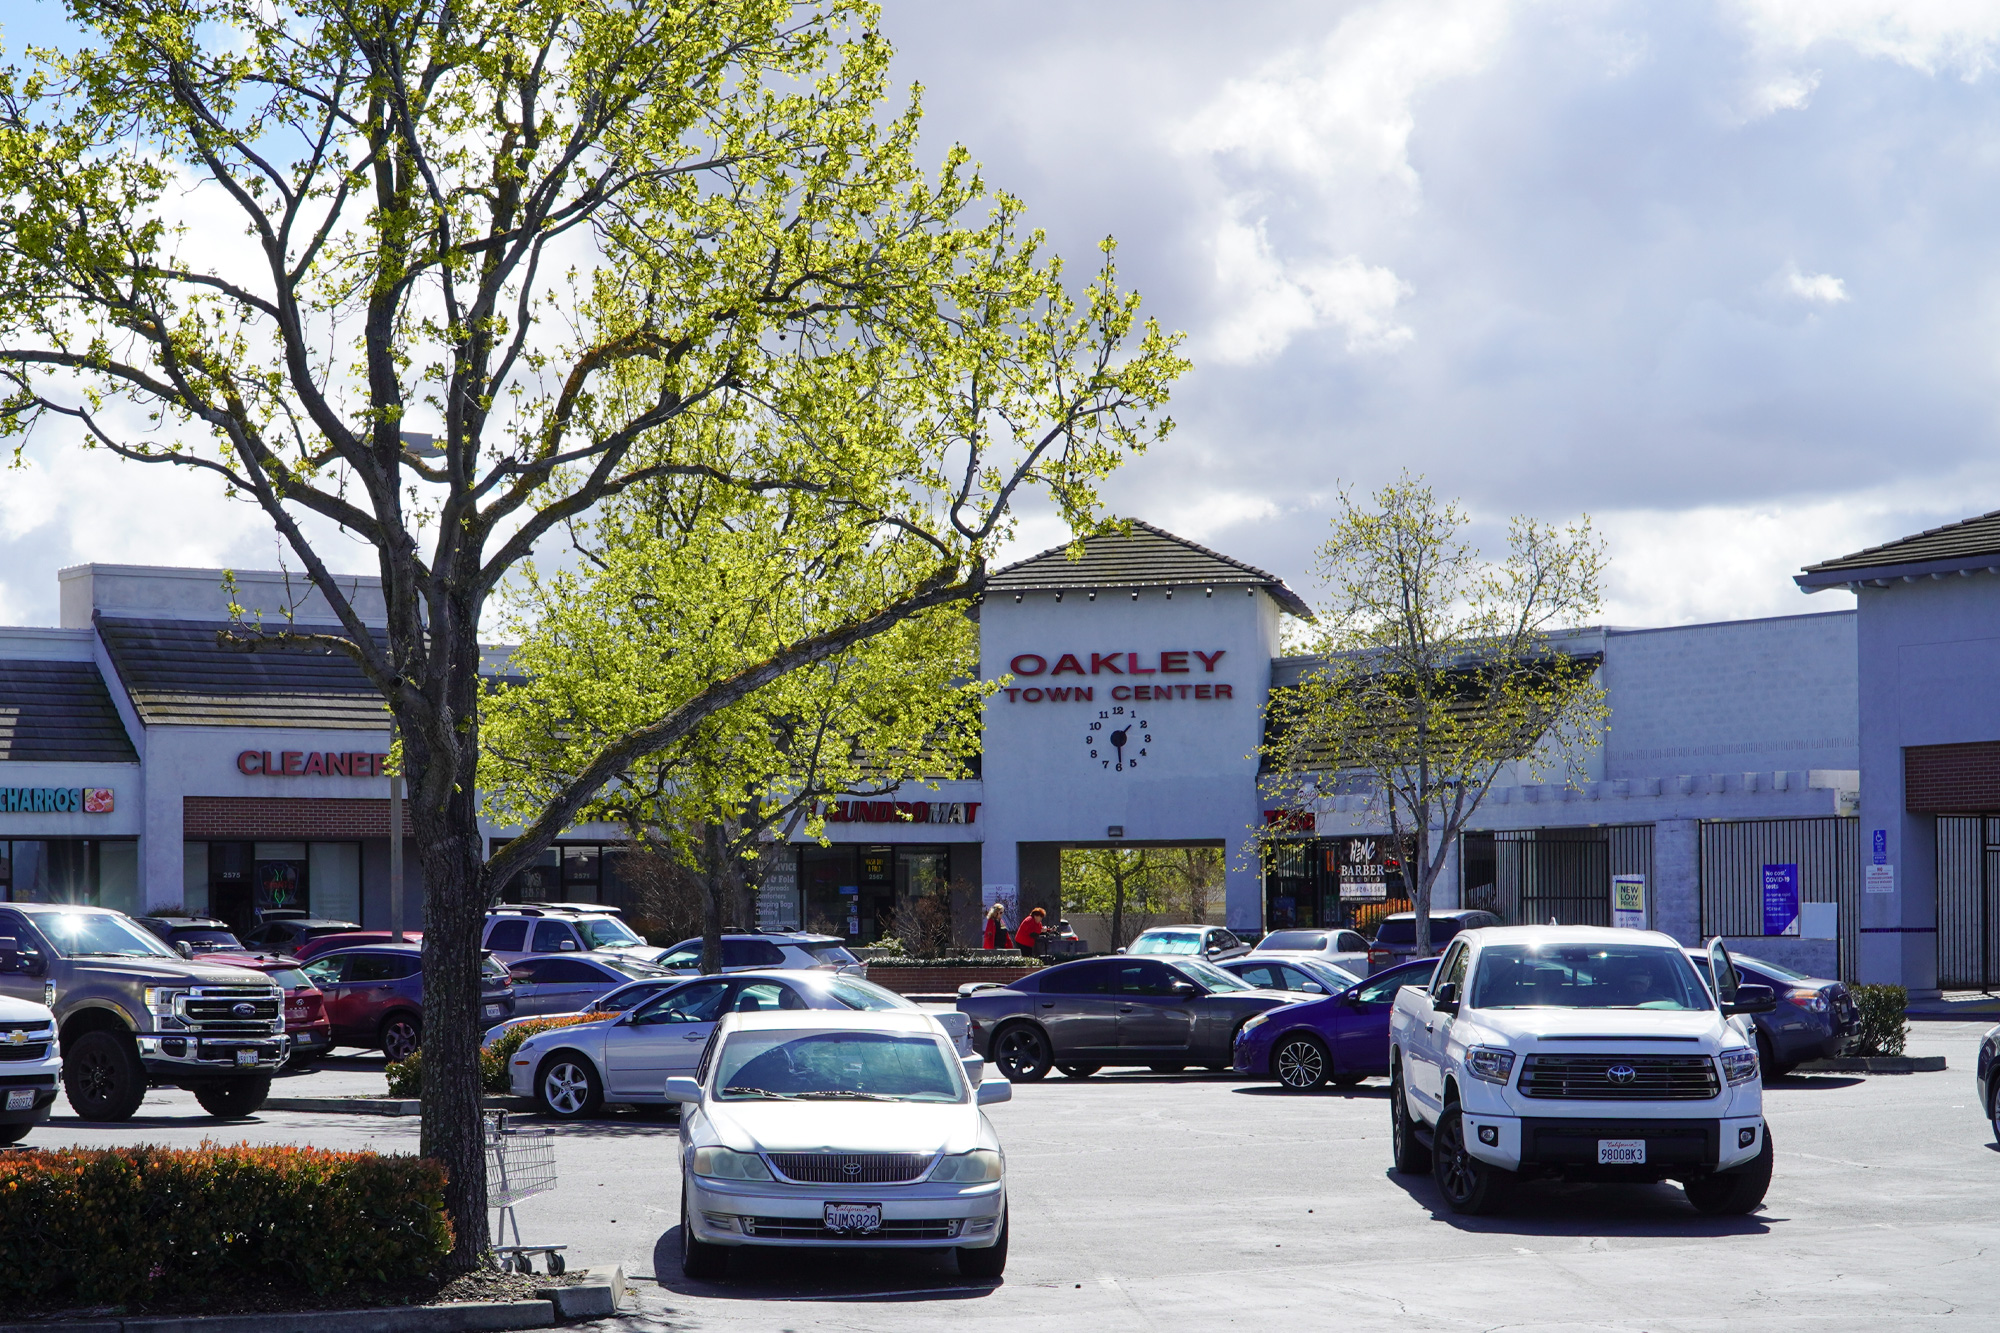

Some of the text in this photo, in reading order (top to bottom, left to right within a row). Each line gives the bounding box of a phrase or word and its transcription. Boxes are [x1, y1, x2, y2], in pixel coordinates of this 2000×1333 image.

[1010, 650, 1226, 676] OAKLEY
[1003, 684, 1233, 703] TOWN CENTER
[1099, 710, 1109, 719] 11
[1112, 706, 1124, 715] 12
[1131, 710, 1136, 718] 1
[1089, 722, 1102, 731] 10
[1140, 720, 1148, 729] 2
[1086, 735, 1093, 744] 9
[1144, 734, 1151, 743] 3
[1090, 749, 1098, 758] 8
[1139, 748, 1147, 756] 4
[238, 750, 404, 777] CLEANER
[1102, 761, 1109, 769] 7
[1115, 763, 1123, 772] 6
[1129, 759, 1137, 768] 5
[1341, 864, 1385, 876] BARBER
[778, 875, 795, 883] Fold
[767, 884, 790, 892] Spreads
[1620, 885, 1639, 894] NEW
[1620, 893, 1639, 901] LOW
[780, 900, 794, 909] Bags
[755, 909, 778, 917] Clothing
[1602, 1148, 1643, 1160] 98008K3
[827, 1212, 877, 1227] 5UMS828
